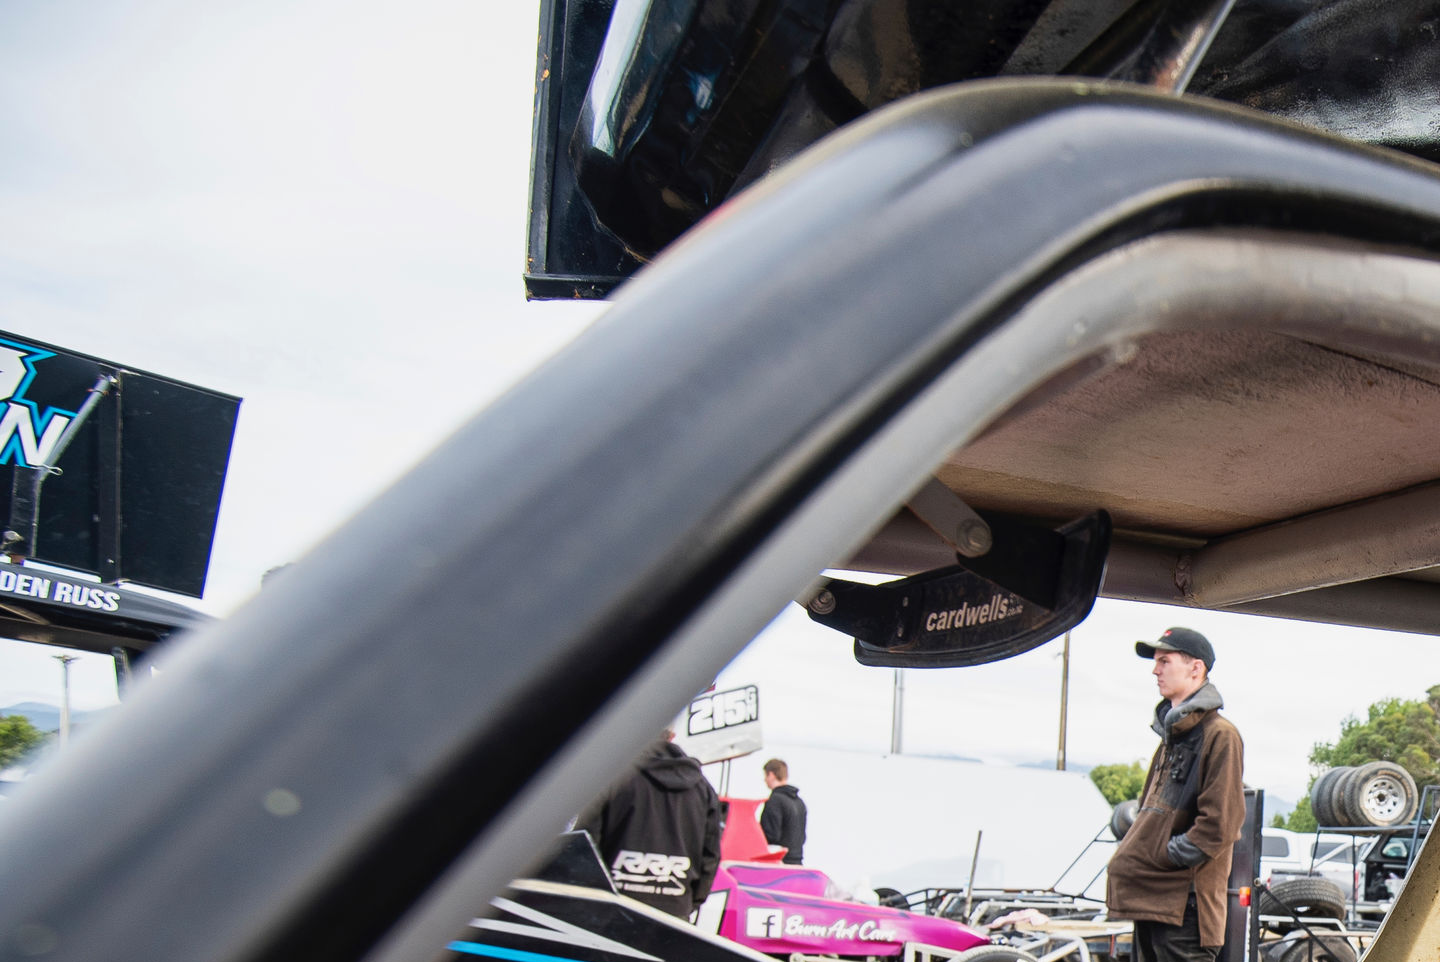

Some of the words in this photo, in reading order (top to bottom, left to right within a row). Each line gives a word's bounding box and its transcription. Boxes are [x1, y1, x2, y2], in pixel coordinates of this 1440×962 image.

[54, 581, 121, 612] RUSS
[926, 593, 1009, 632] cardwells
[612, 850, 691, 879] RRR
